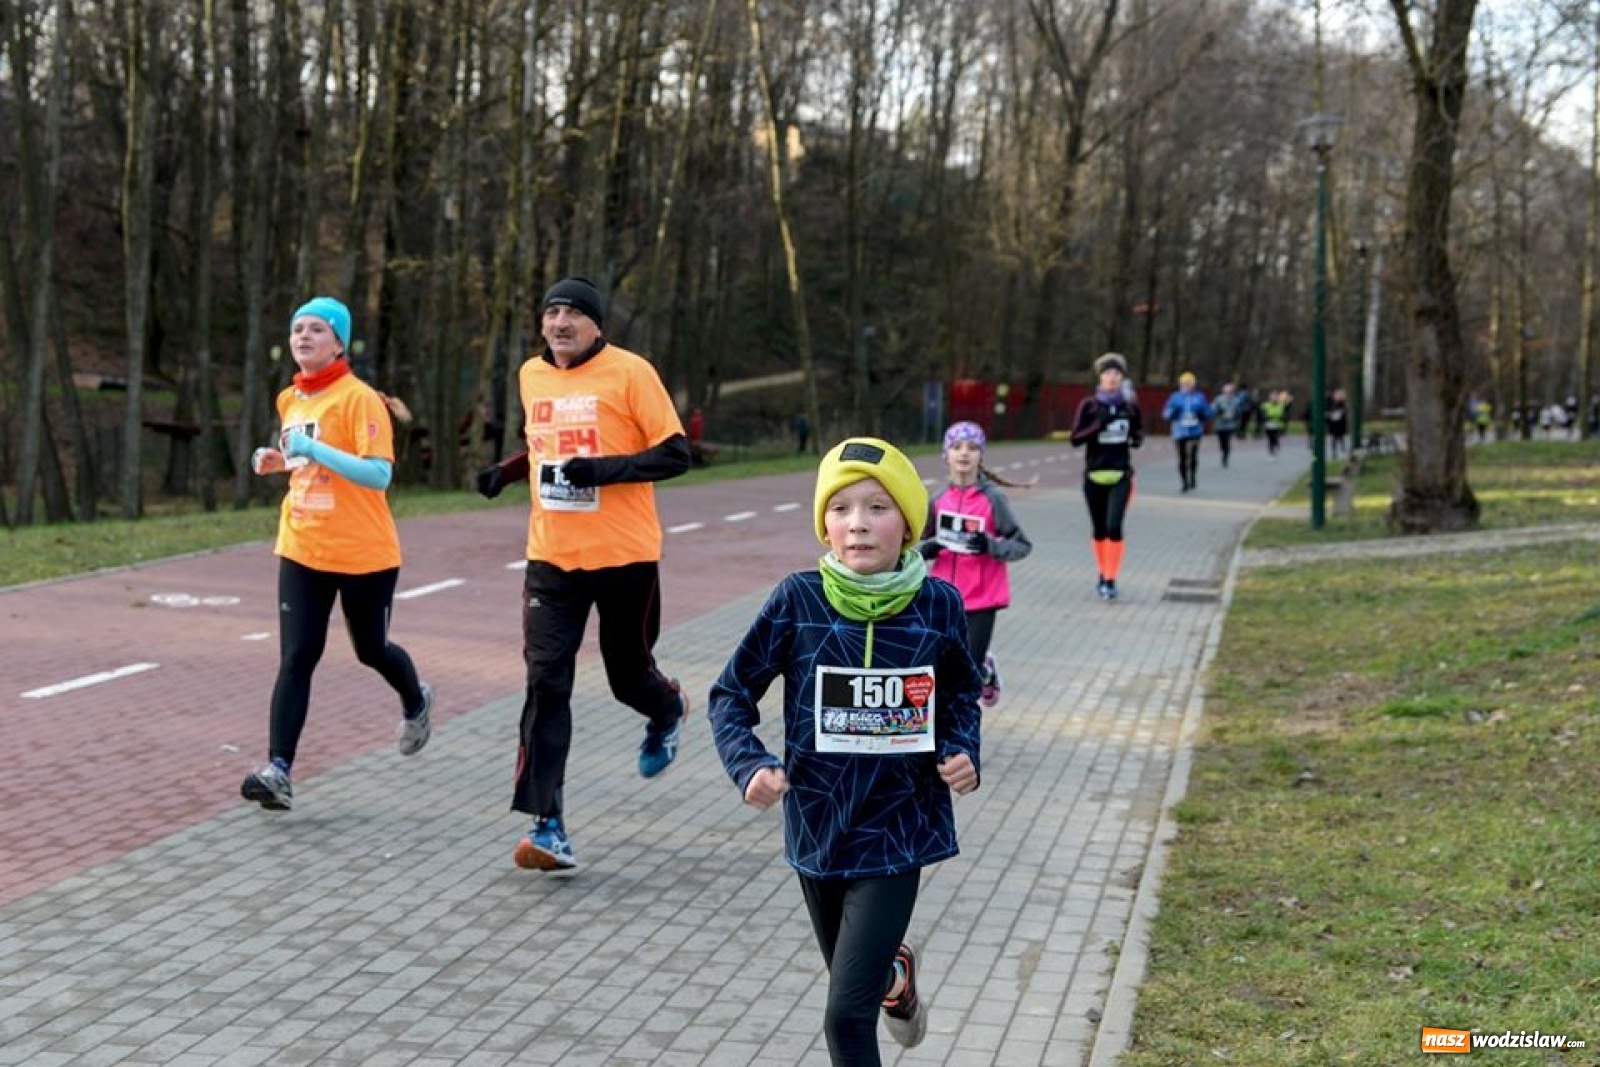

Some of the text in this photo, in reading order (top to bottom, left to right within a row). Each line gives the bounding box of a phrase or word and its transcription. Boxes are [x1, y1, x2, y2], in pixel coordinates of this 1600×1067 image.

[532, 399, 553, 423] 10
[558, 429, 599, 456] 24
[849, 676, 904, 708] 150
